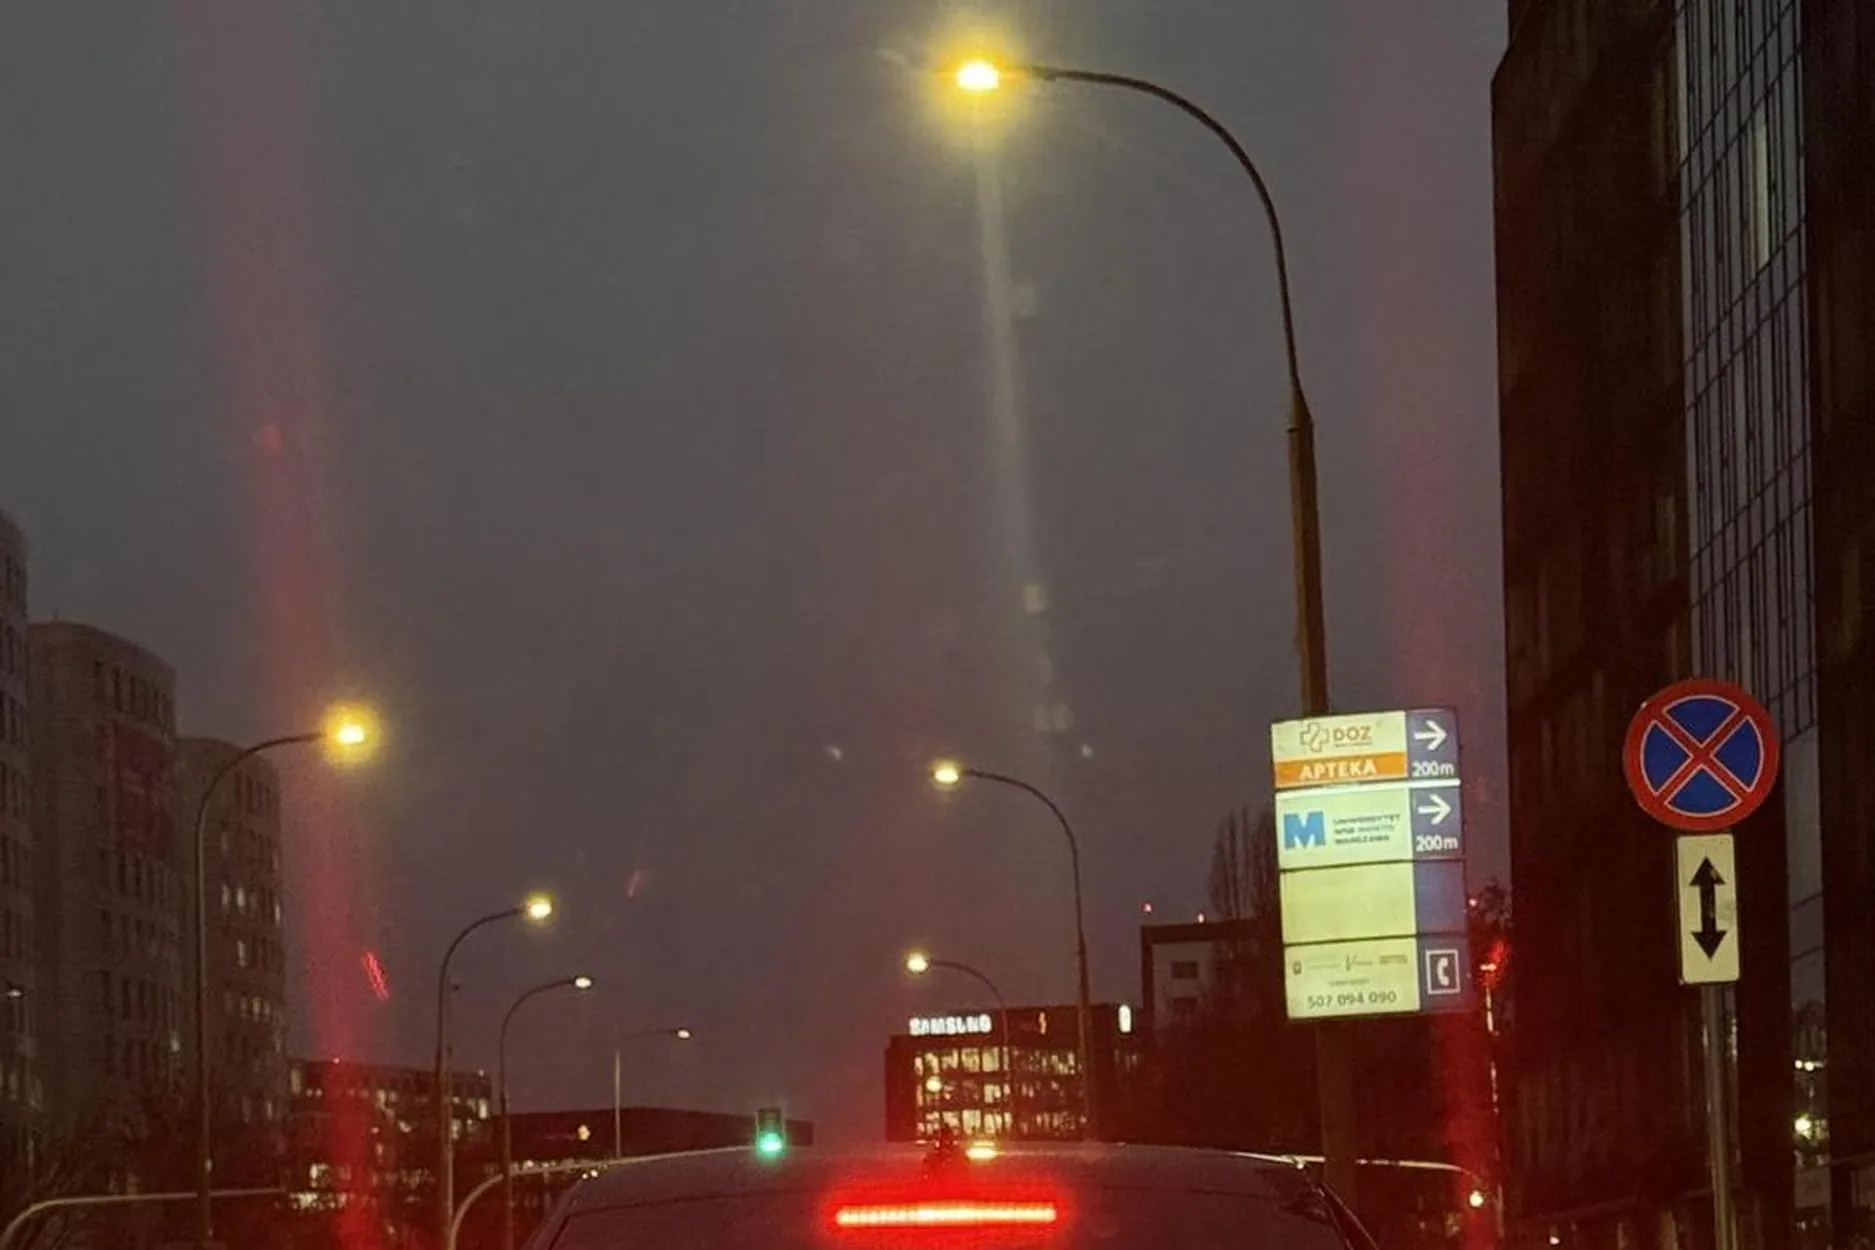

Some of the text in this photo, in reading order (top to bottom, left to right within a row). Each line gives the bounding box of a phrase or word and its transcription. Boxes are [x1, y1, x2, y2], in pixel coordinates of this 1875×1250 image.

[1333, 726, 1372, 742] DOZ
[1299, 759, 1377, 780] APTEKA
[1307, 994, 1333, 1009] 507
[1337, 992, 1364, 1006] 094
